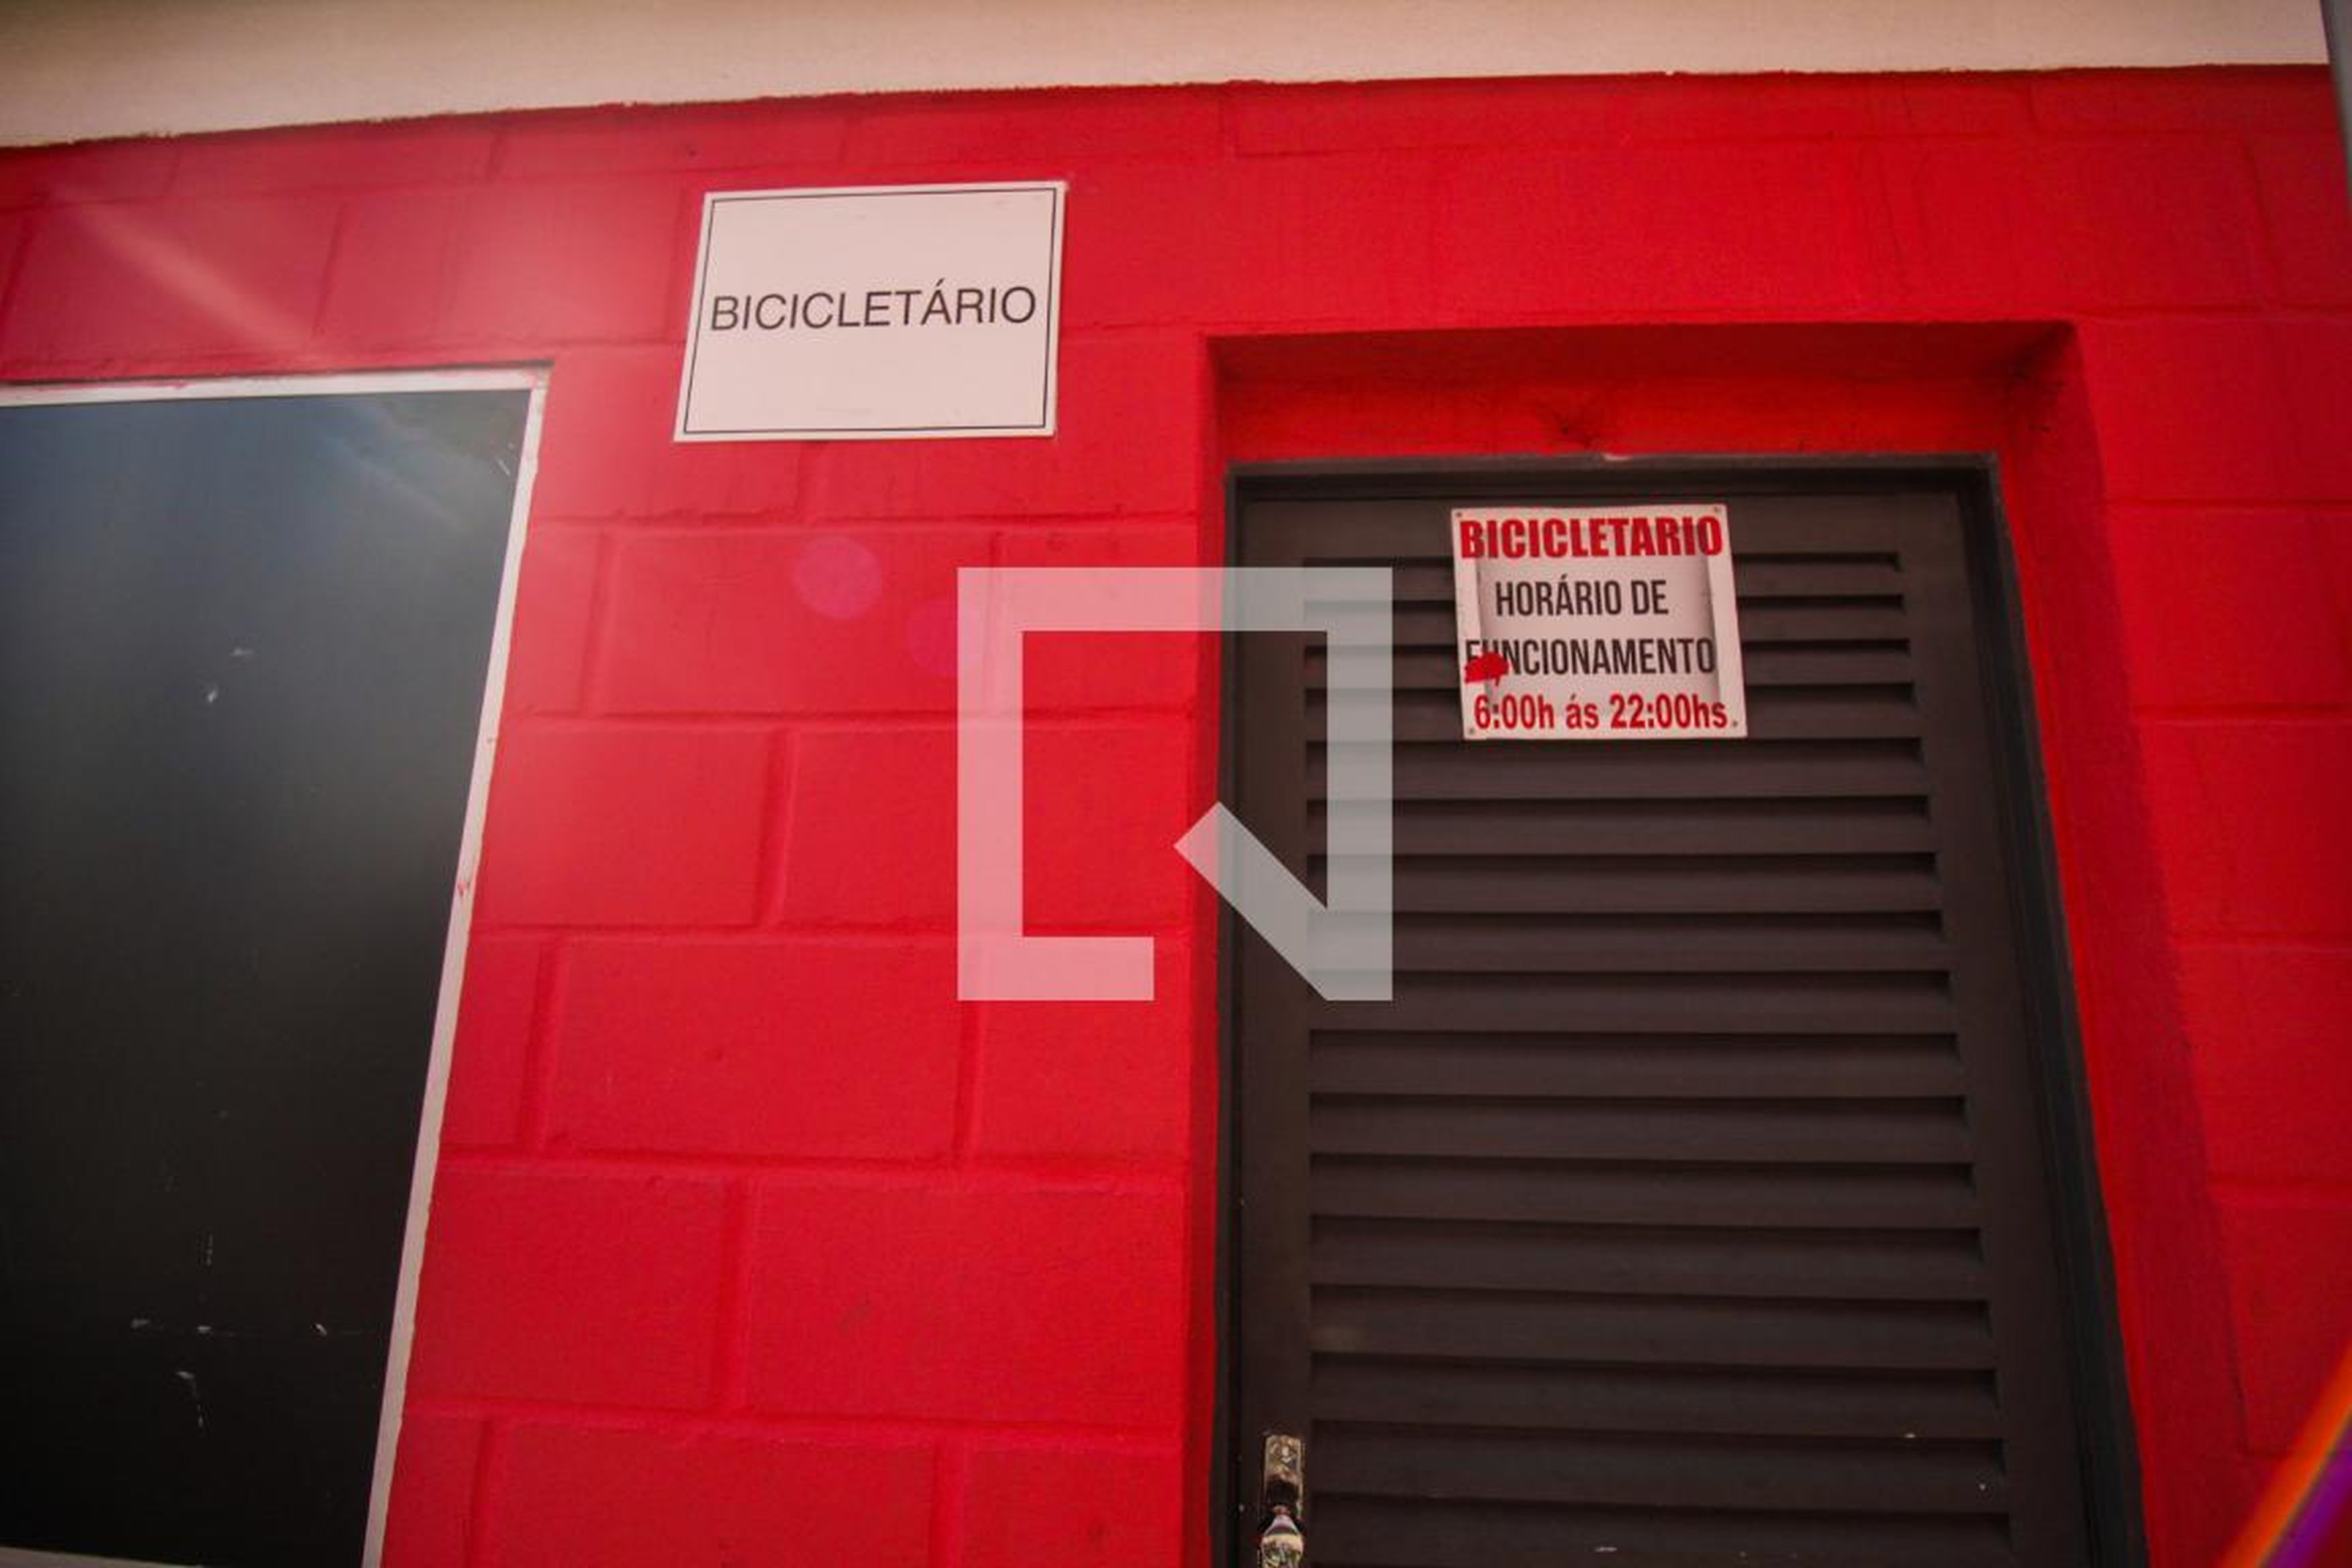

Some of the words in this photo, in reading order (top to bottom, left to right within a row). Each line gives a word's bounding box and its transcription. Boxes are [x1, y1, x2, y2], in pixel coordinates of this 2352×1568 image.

[710, 278, 1036, 331] BICICLETÁRIO
[1460, 516, 1723, 559] BICICLETARIO
[1496, 573, 1622, 617] HORÁRIO
[1632, 579, 1670, 615] DE
[1474, 694, 1555, 729] 6:00h
[1566, 693, 1600, 729] ás
[1610, 693, 1728, 729] 22:00hs
